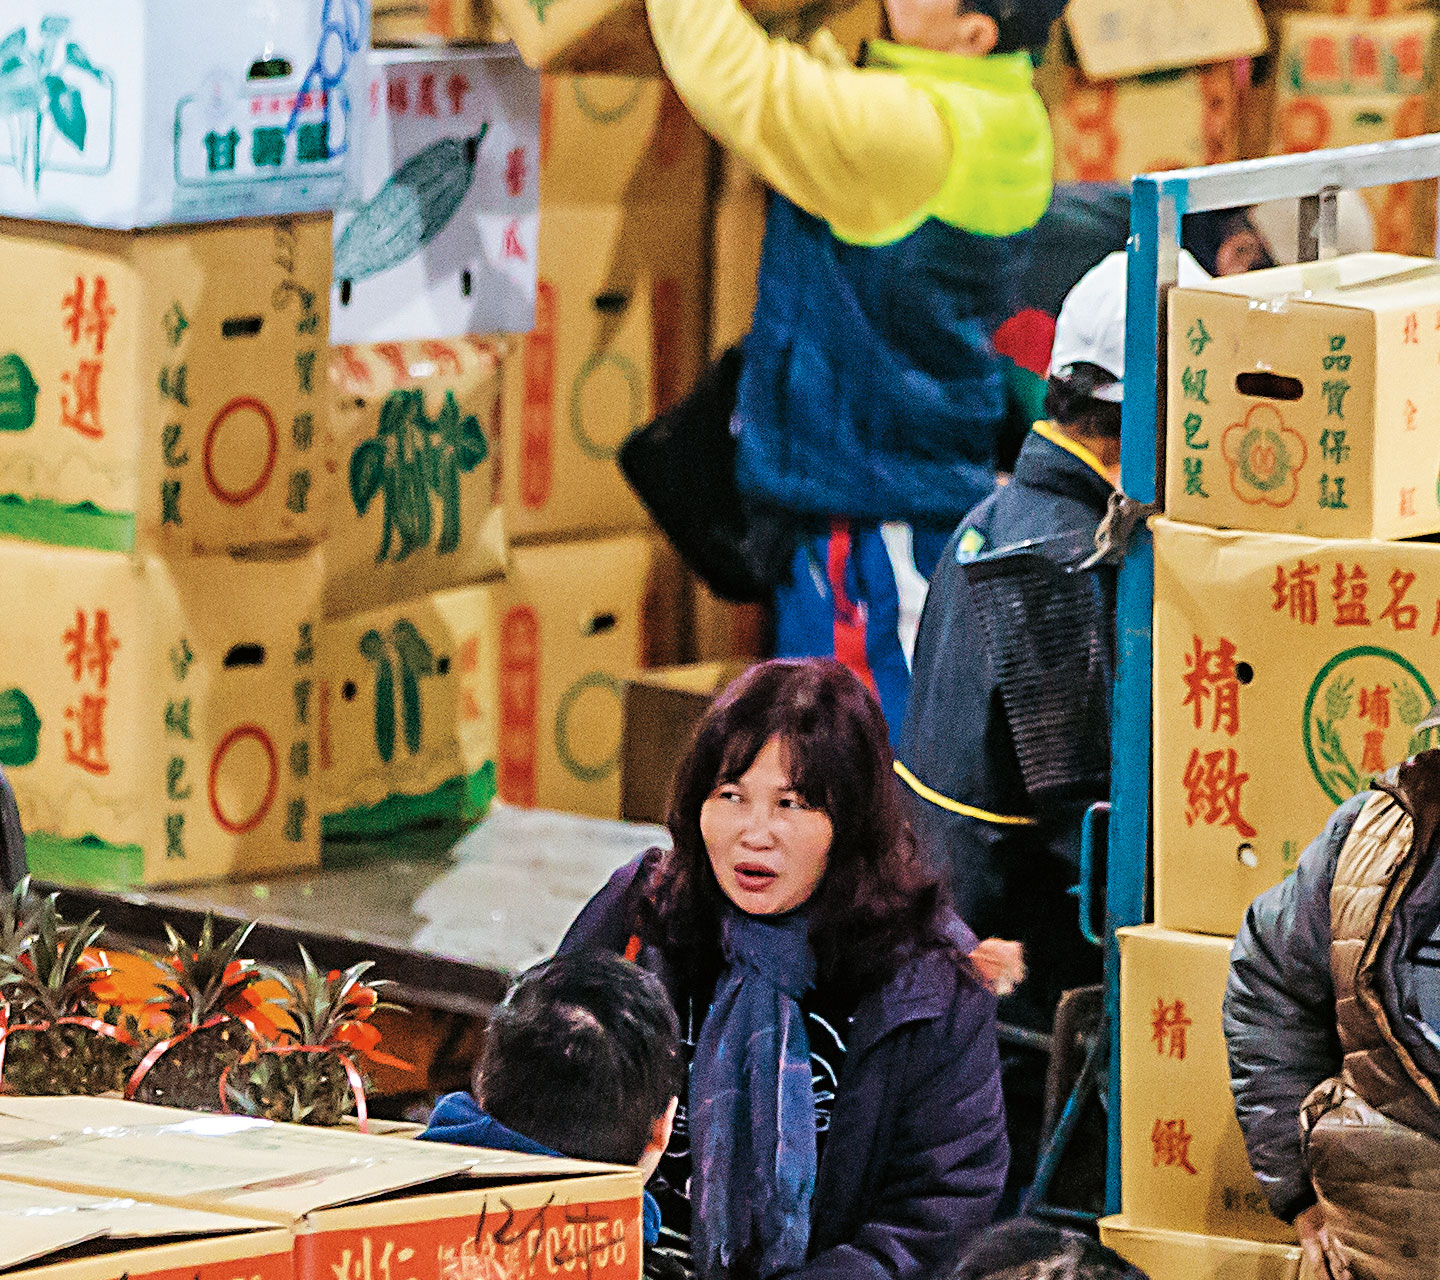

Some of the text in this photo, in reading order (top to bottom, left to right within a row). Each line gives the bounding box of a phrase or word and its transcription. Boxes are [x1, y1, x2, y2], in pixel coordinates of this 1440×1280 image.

[1181, 320, 1210, 495] 分級包裝
[1183, 637, 1256, 838] 精緻
[1151, 999, 1197, 1175] 精緻
